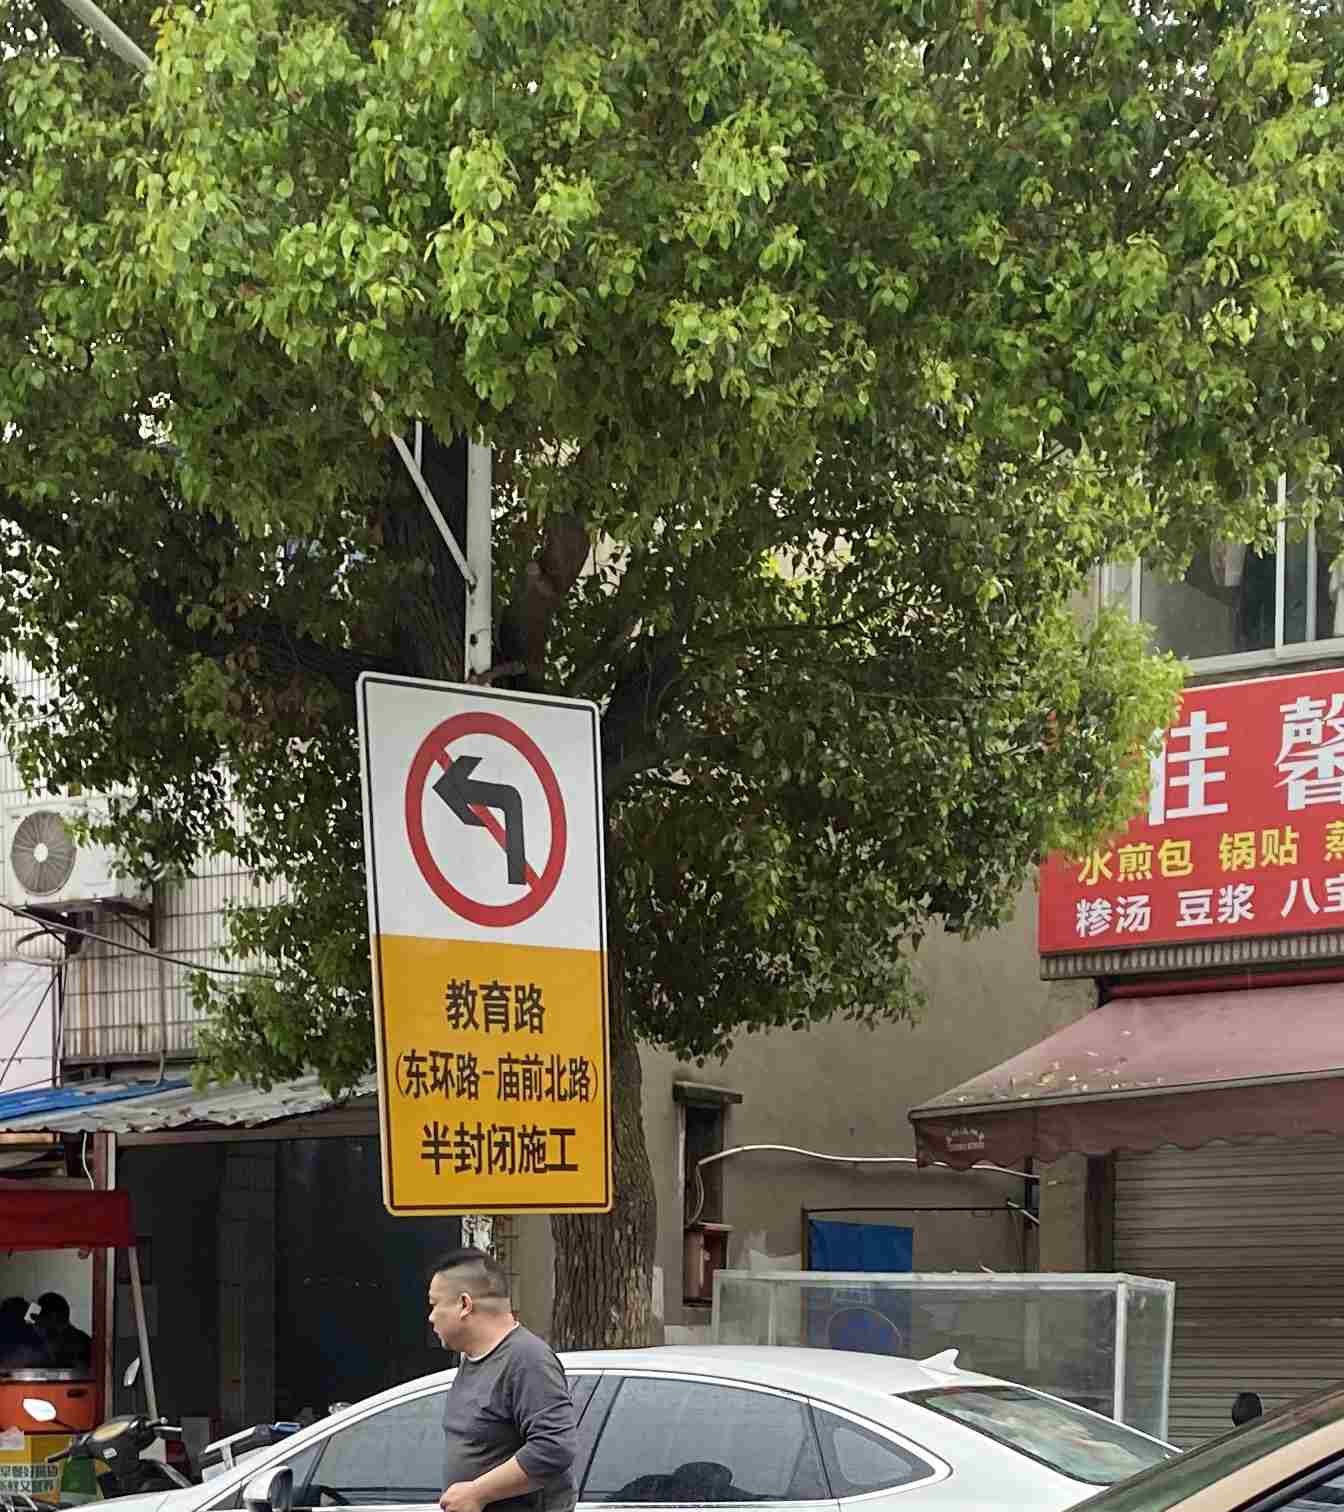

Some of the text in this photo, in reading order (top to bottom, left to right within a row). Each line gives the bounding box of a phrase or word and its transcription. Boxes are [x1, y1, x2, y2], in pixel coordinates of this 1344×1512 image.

[1077, 838, 1194, 887] 水煎包
[1218, 826, 1300, 873] 锅贴
[1176, 884, 1256, 928] 豆浆
[446, 978, 546, 1034] 教育路
[420, 1120, 579, 1175] 半封闭施工
